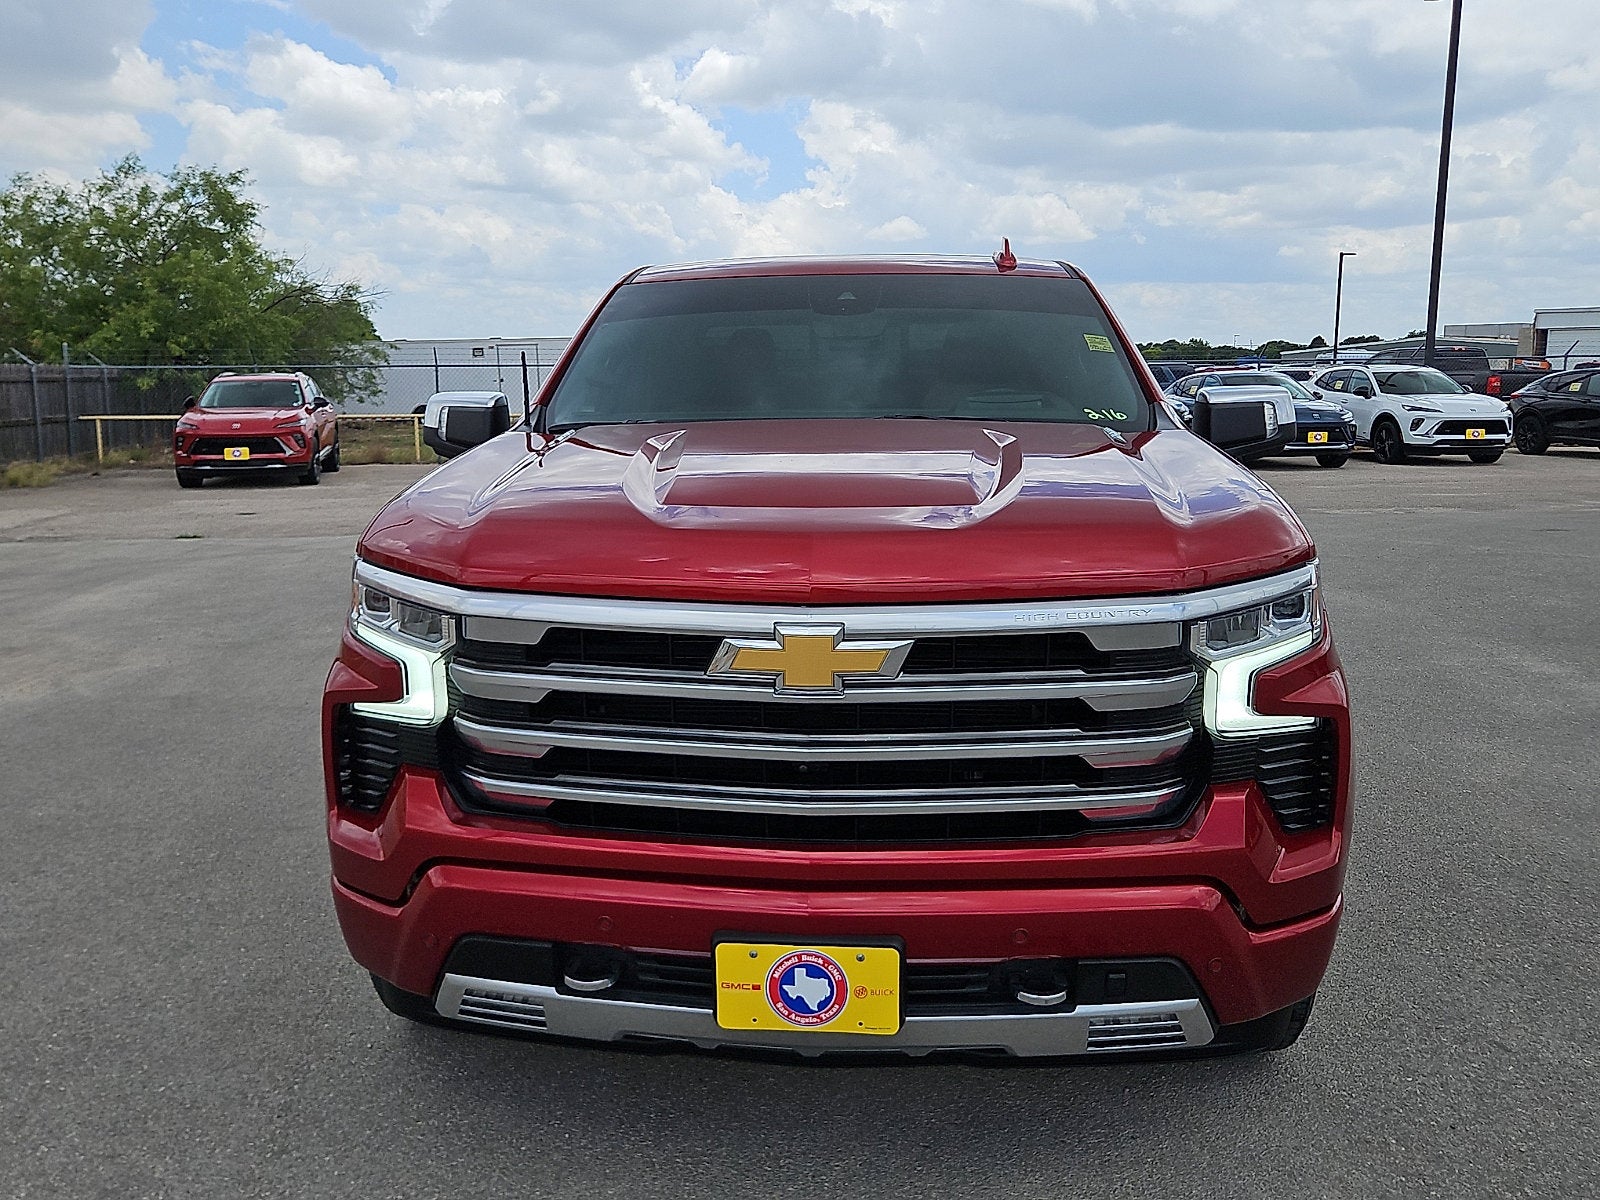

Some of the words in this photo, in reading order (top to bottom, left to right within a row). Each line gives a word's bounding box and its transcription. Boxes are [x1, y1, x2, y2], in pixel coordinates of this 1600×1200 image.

[1014, 613, 1059, 622] HIGH
[1066, 609, 1153, 619] COUNTRY
[801, 954, 824, 965] Buick
[827, 964, 842, 980] GMC
[721, 982, 750, 991] GMC
[870, 988, 895, 996] BUICK
[775, 1002, 789, 1016] San
[819, 1004, 840, 1020] Texas
